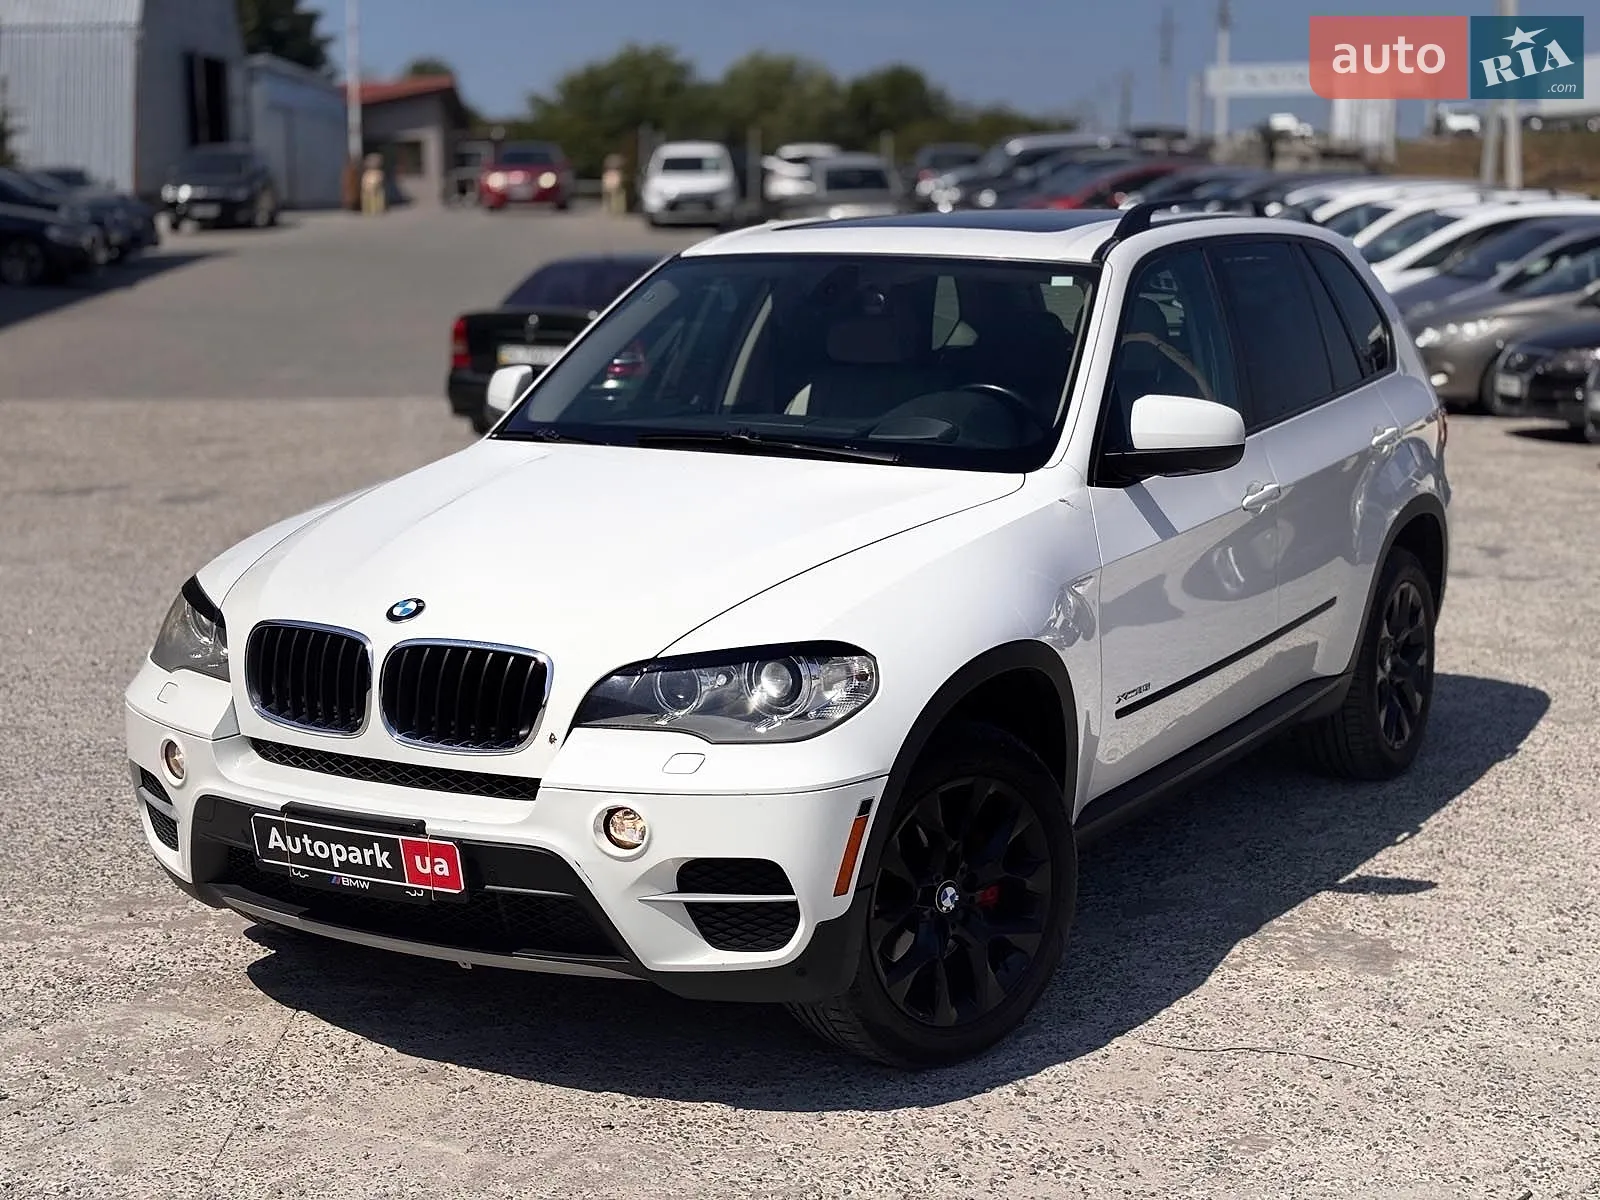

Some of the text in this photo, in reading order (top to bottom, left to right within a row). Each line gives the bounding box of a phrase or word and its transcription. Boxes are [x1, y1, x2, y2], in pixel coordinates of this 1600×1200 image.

[268, 827, 450, 877] Autopark ua
[341, 877, 370, 890] BMW
